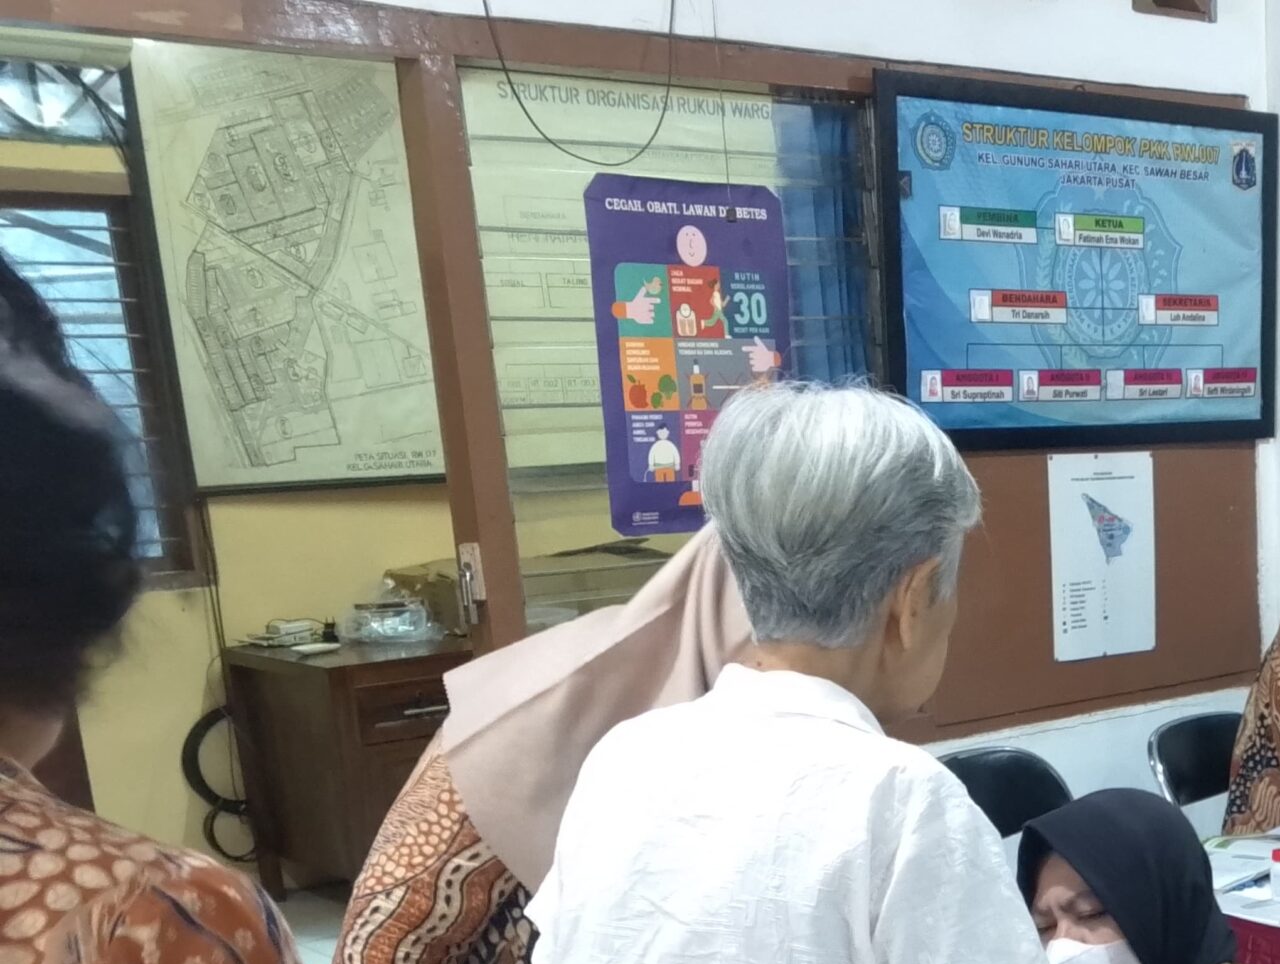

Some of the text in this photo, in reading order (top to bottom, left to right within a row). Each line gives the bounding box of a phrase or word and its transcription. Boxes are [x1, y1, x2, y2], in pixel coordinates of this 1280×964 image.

[496, 81, 772, 120] STRUKTUR ORGANISASI RUKUN WARG
[962, 121, 1049, 149] STRUKTUR
[1053, 129, 1137, 158] KELOMPOK
[1139, 138, 1172, 161] PKK
[1002, 154, 1045, 169] GUNUNG
[1048, 158, 1083, 171] SAHARI
[1144, 167, 1178, 180] SAWAH
[1180, 169, 1210, 182] BESAR
[1060, 175, 1136, 190] JAKARTA PUSAT
[605, 198, 768, 220] CEGAH. OBATI. LAWAN DBETES
[1094, 217, 1124, 229] KETUA
[734, 272, 760, 281] RUTIN
[733, 291, 767, 325] 30
[1001, 293, 1058, 305] BENDAHARA
[951, 390, 961, 399] Sri
